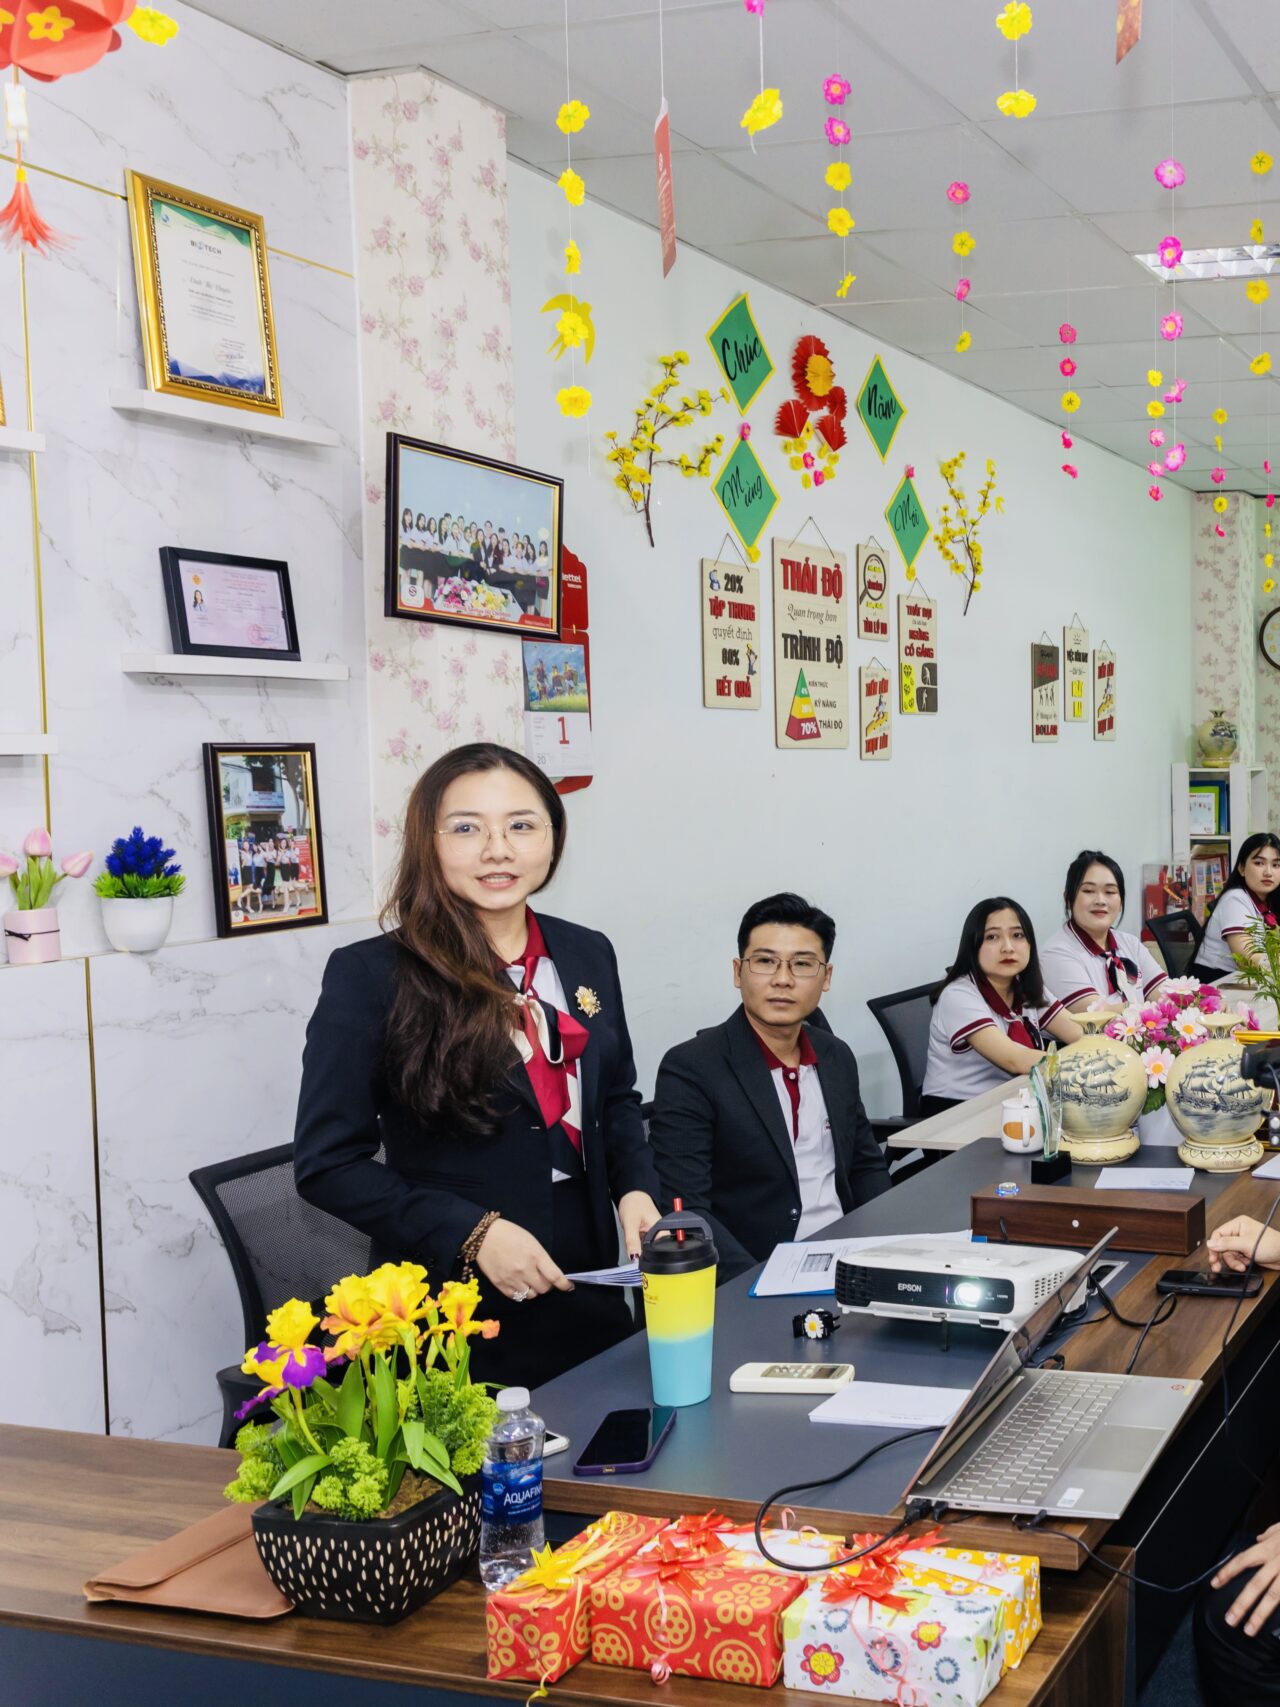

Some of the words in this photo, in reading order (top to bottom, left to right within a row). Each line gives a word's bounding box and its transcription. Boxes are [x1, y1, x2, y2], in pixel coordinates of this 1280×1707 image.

[562, 572, 582, 584] iettel
[723, 573, 744, 594] 20%
[728, 600, 756, 622] TRUNG
[781, 629, 821, 662] TRÌNH
[558, 716, 570, 745] 1
[800, 722, 817, 736] 70%
[897, 1283, 922, 1293] EPSON
